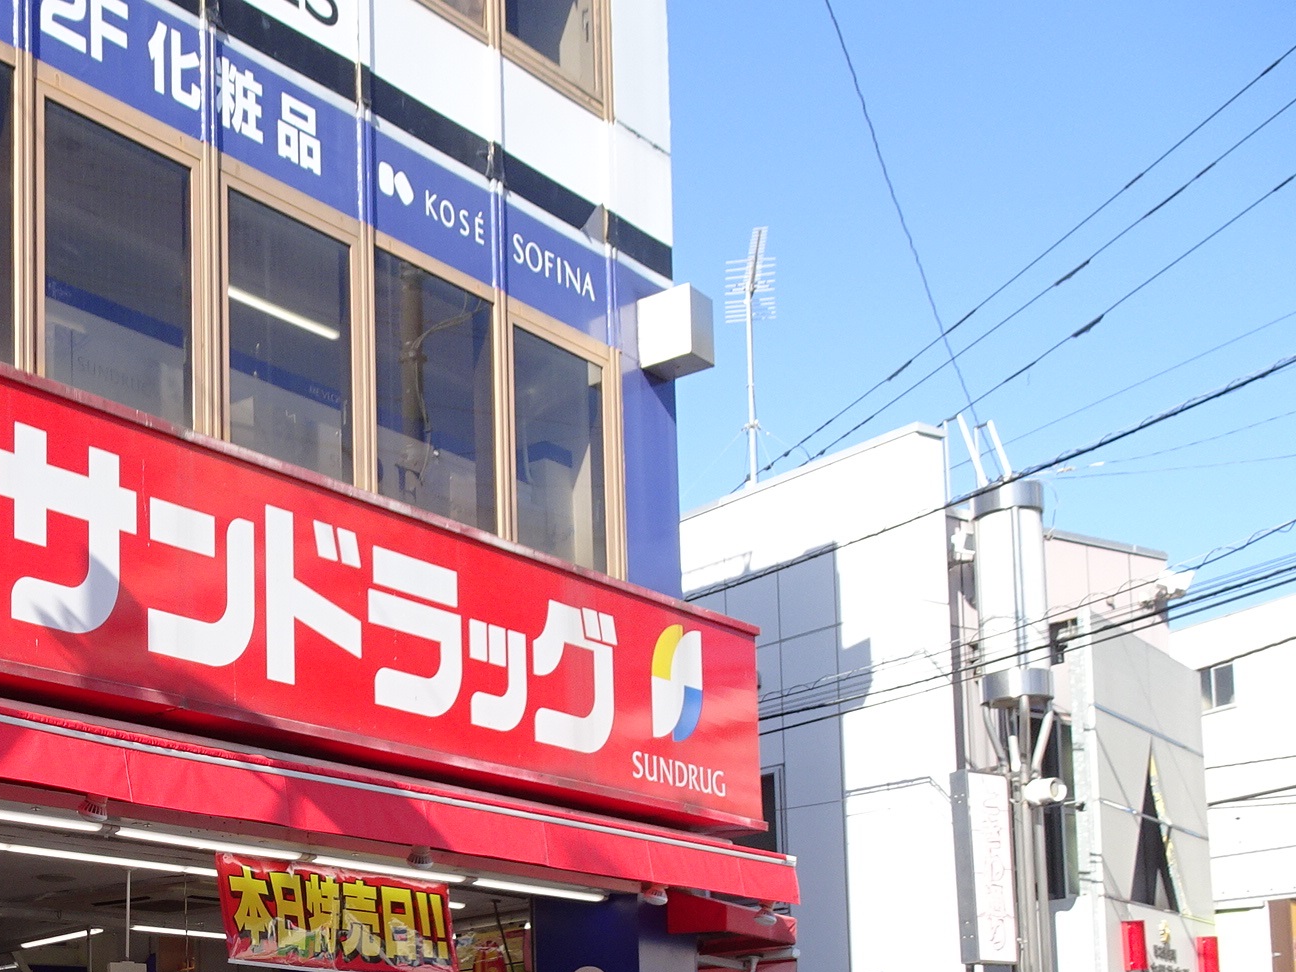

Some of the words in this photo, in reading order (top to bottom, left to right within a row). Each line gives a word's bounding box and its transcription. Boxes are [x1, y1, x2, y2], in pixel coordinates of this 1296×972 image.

[148, 21, 321, 176] 化粧品
[425, 188, 485, 246] KOSÉ
[512, 233, 596, 302] SOFINA
[632, 751, 726, 798] SUNDRUG
